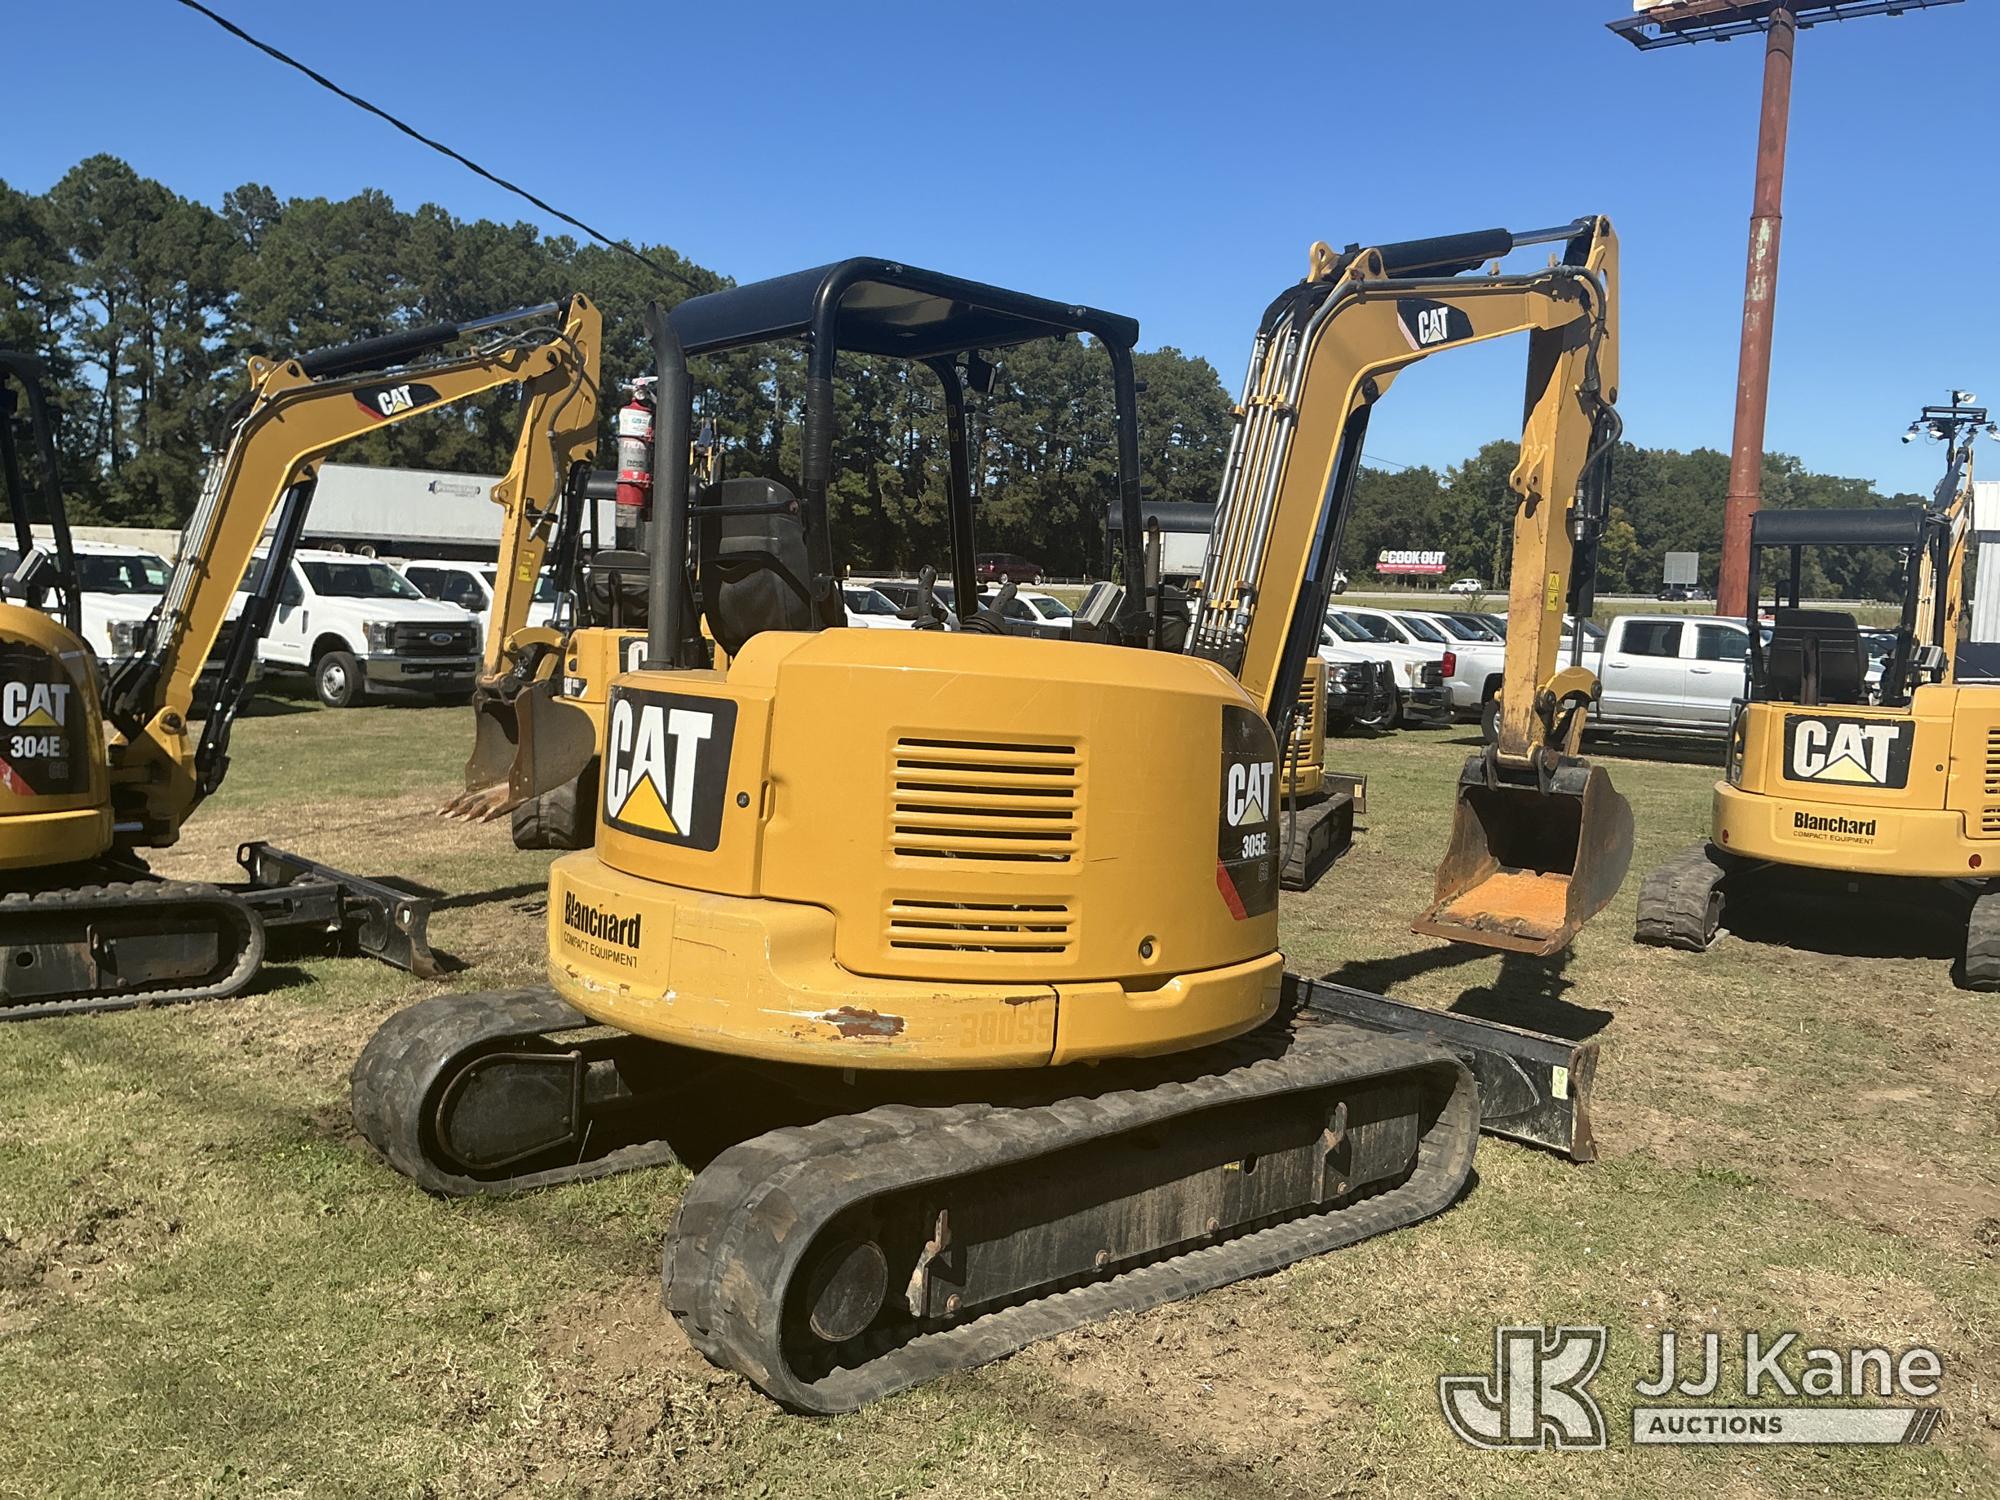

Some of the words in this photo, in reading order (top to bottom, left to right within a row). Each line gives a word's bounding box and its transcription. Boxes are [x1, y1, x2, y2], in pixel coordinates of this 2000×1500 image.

[1418, 307, 1448, 344] CAT
[378, 385, 413, 415] CAT
[3, 682, 70, 727] CAT
[607, 699, 713, 836] CAT
[1793, 720, 1899, 783] CAT
[1227, 762, 1273, 826] CAT
[1793, 830, 1828, 841] COMPACT
[1830, 834, 1875, 845] EQUIPMENT
[1794, 811, 1877, 836] Blanchard
[563, 931, 589, 953] COMPACT
[590, 944, 638, 969] EQUIPMENT
